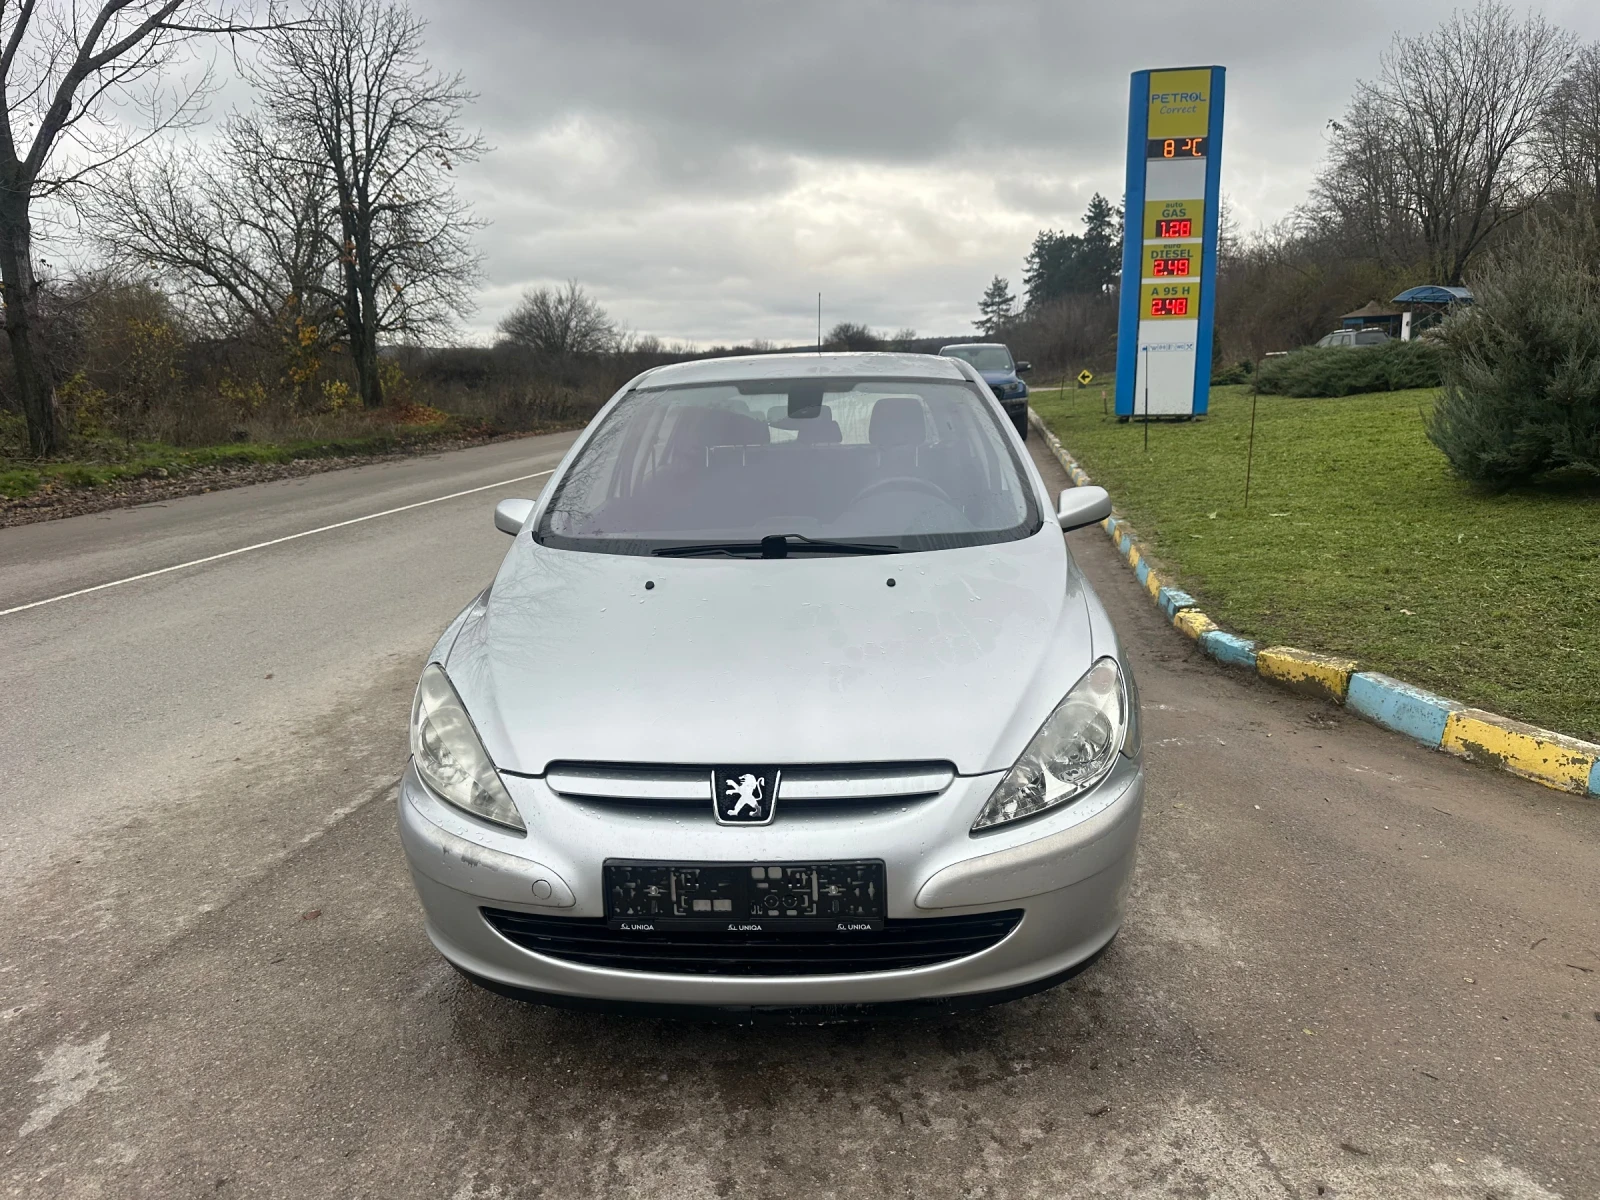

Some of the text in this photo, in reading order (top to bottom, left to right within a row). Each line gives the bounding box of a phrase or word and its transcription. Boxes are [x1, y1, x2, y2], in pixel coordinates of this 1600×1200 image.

[1151, 92, 1207, 104] PETROL
[1159, 104, 1197, 115] Correct
[1163, 139, 1175, 158] 8
[1161, 208, 1187, 218] GAS
[1150, 249, 1194, 259] DIESEL
[1153, 259, 1189, 276] 2.49
[1151, 286, 1190, 296] A 95 H
[1151, 298, 1187, 316] 2.48
